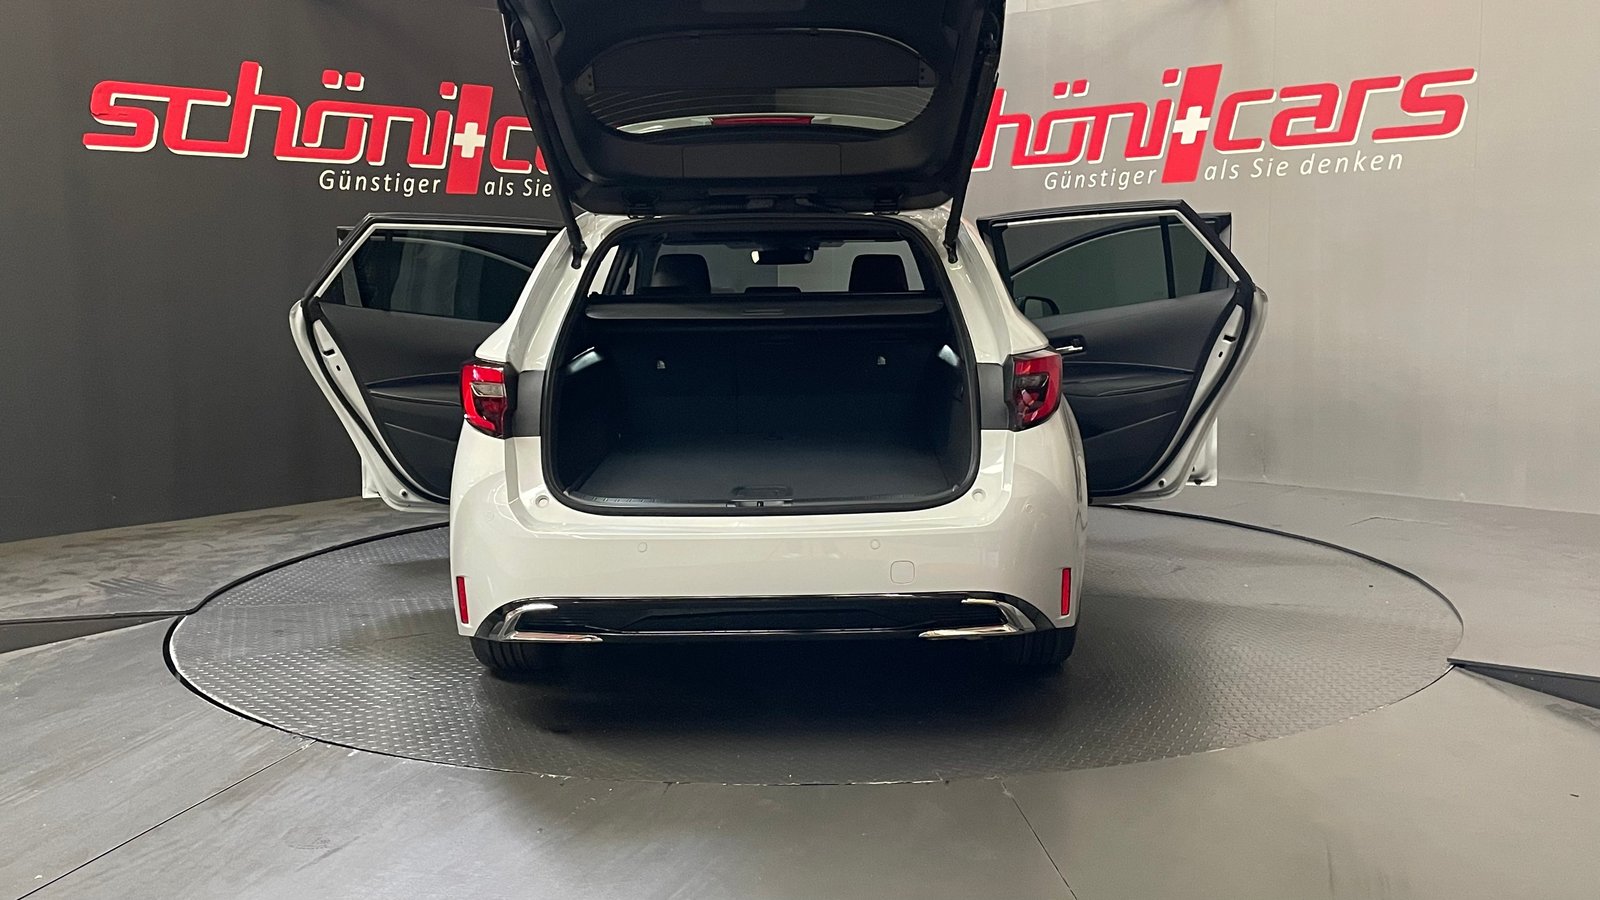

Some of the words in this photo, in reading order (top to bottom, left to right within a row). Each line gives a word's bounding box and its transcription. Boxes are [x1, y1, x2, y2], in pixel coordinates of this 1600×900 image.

[319, 169, 441, 198] Günstiger
[484, 176, 514, 196] als
[522, 178, 553, 198] Sie
[1043, 168, 1158, 192] Günstiger
[1204, 161, 1239, 182] als
[1250, 156, 1288, 178] Sie
[1299, 151, 1404, 176] denken
